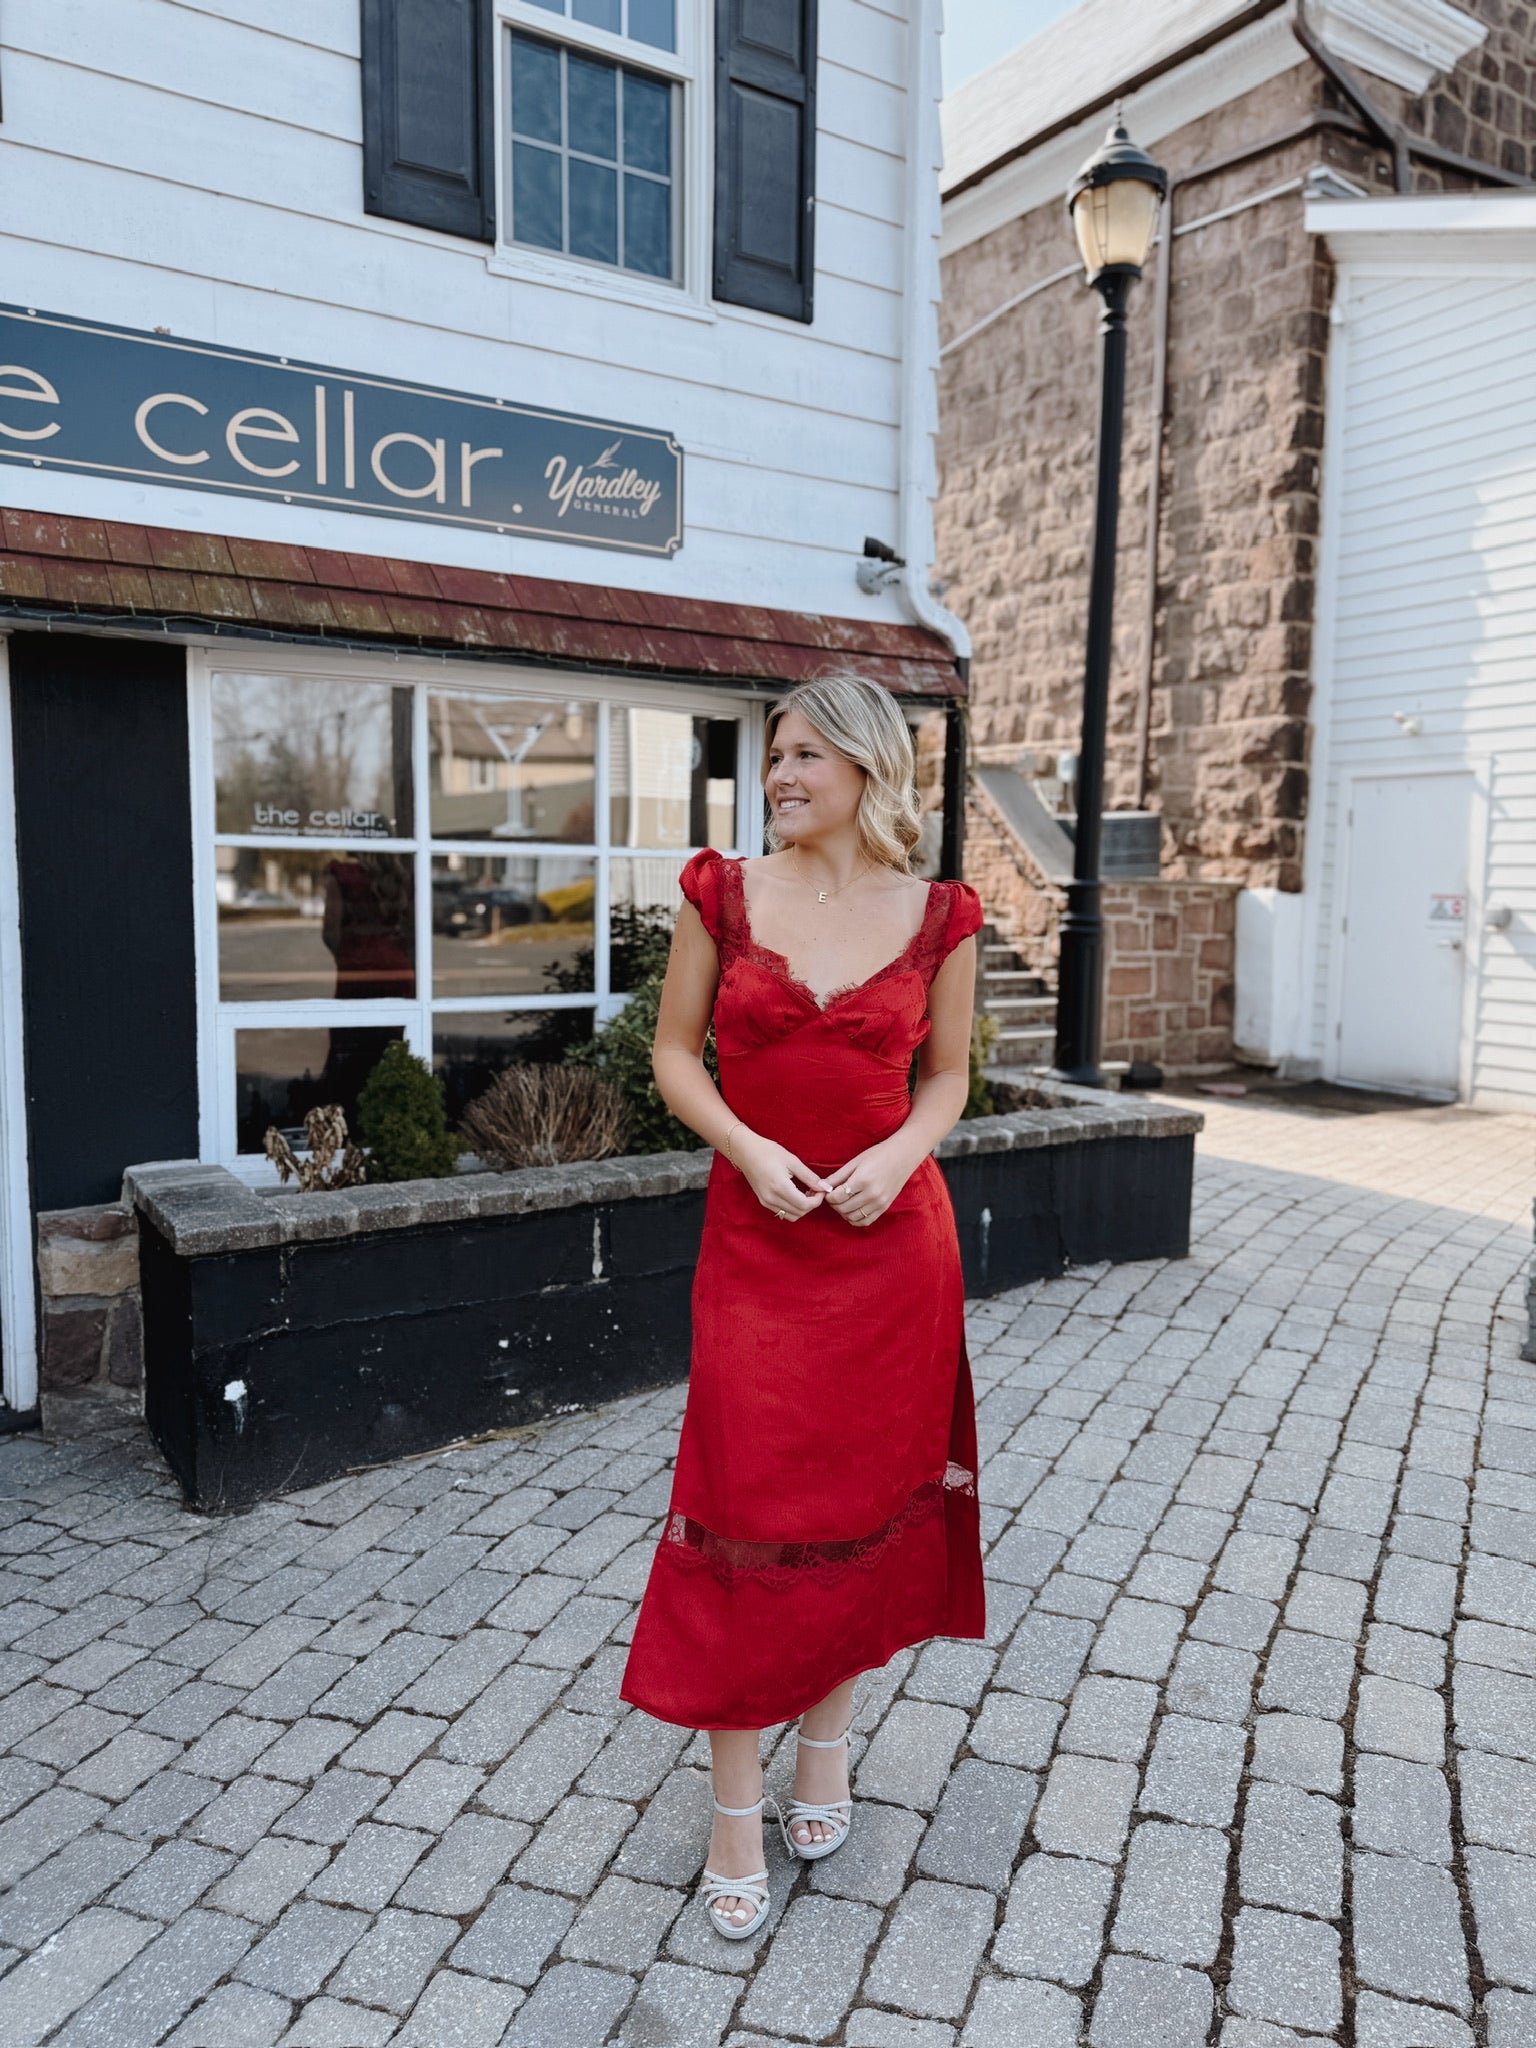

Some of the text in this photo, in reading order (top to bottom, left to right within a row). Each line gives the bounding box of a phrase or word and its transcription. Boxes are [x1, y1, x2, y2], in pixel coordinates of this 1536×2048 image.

[134, 384, 523, 514] cellar.
[544, 455, 662, 518] Yardley
[573, 499, 639, 519] GENERAL
[254, 801, 384, 828] the cellar.
[818, 891, 828, 904] E
